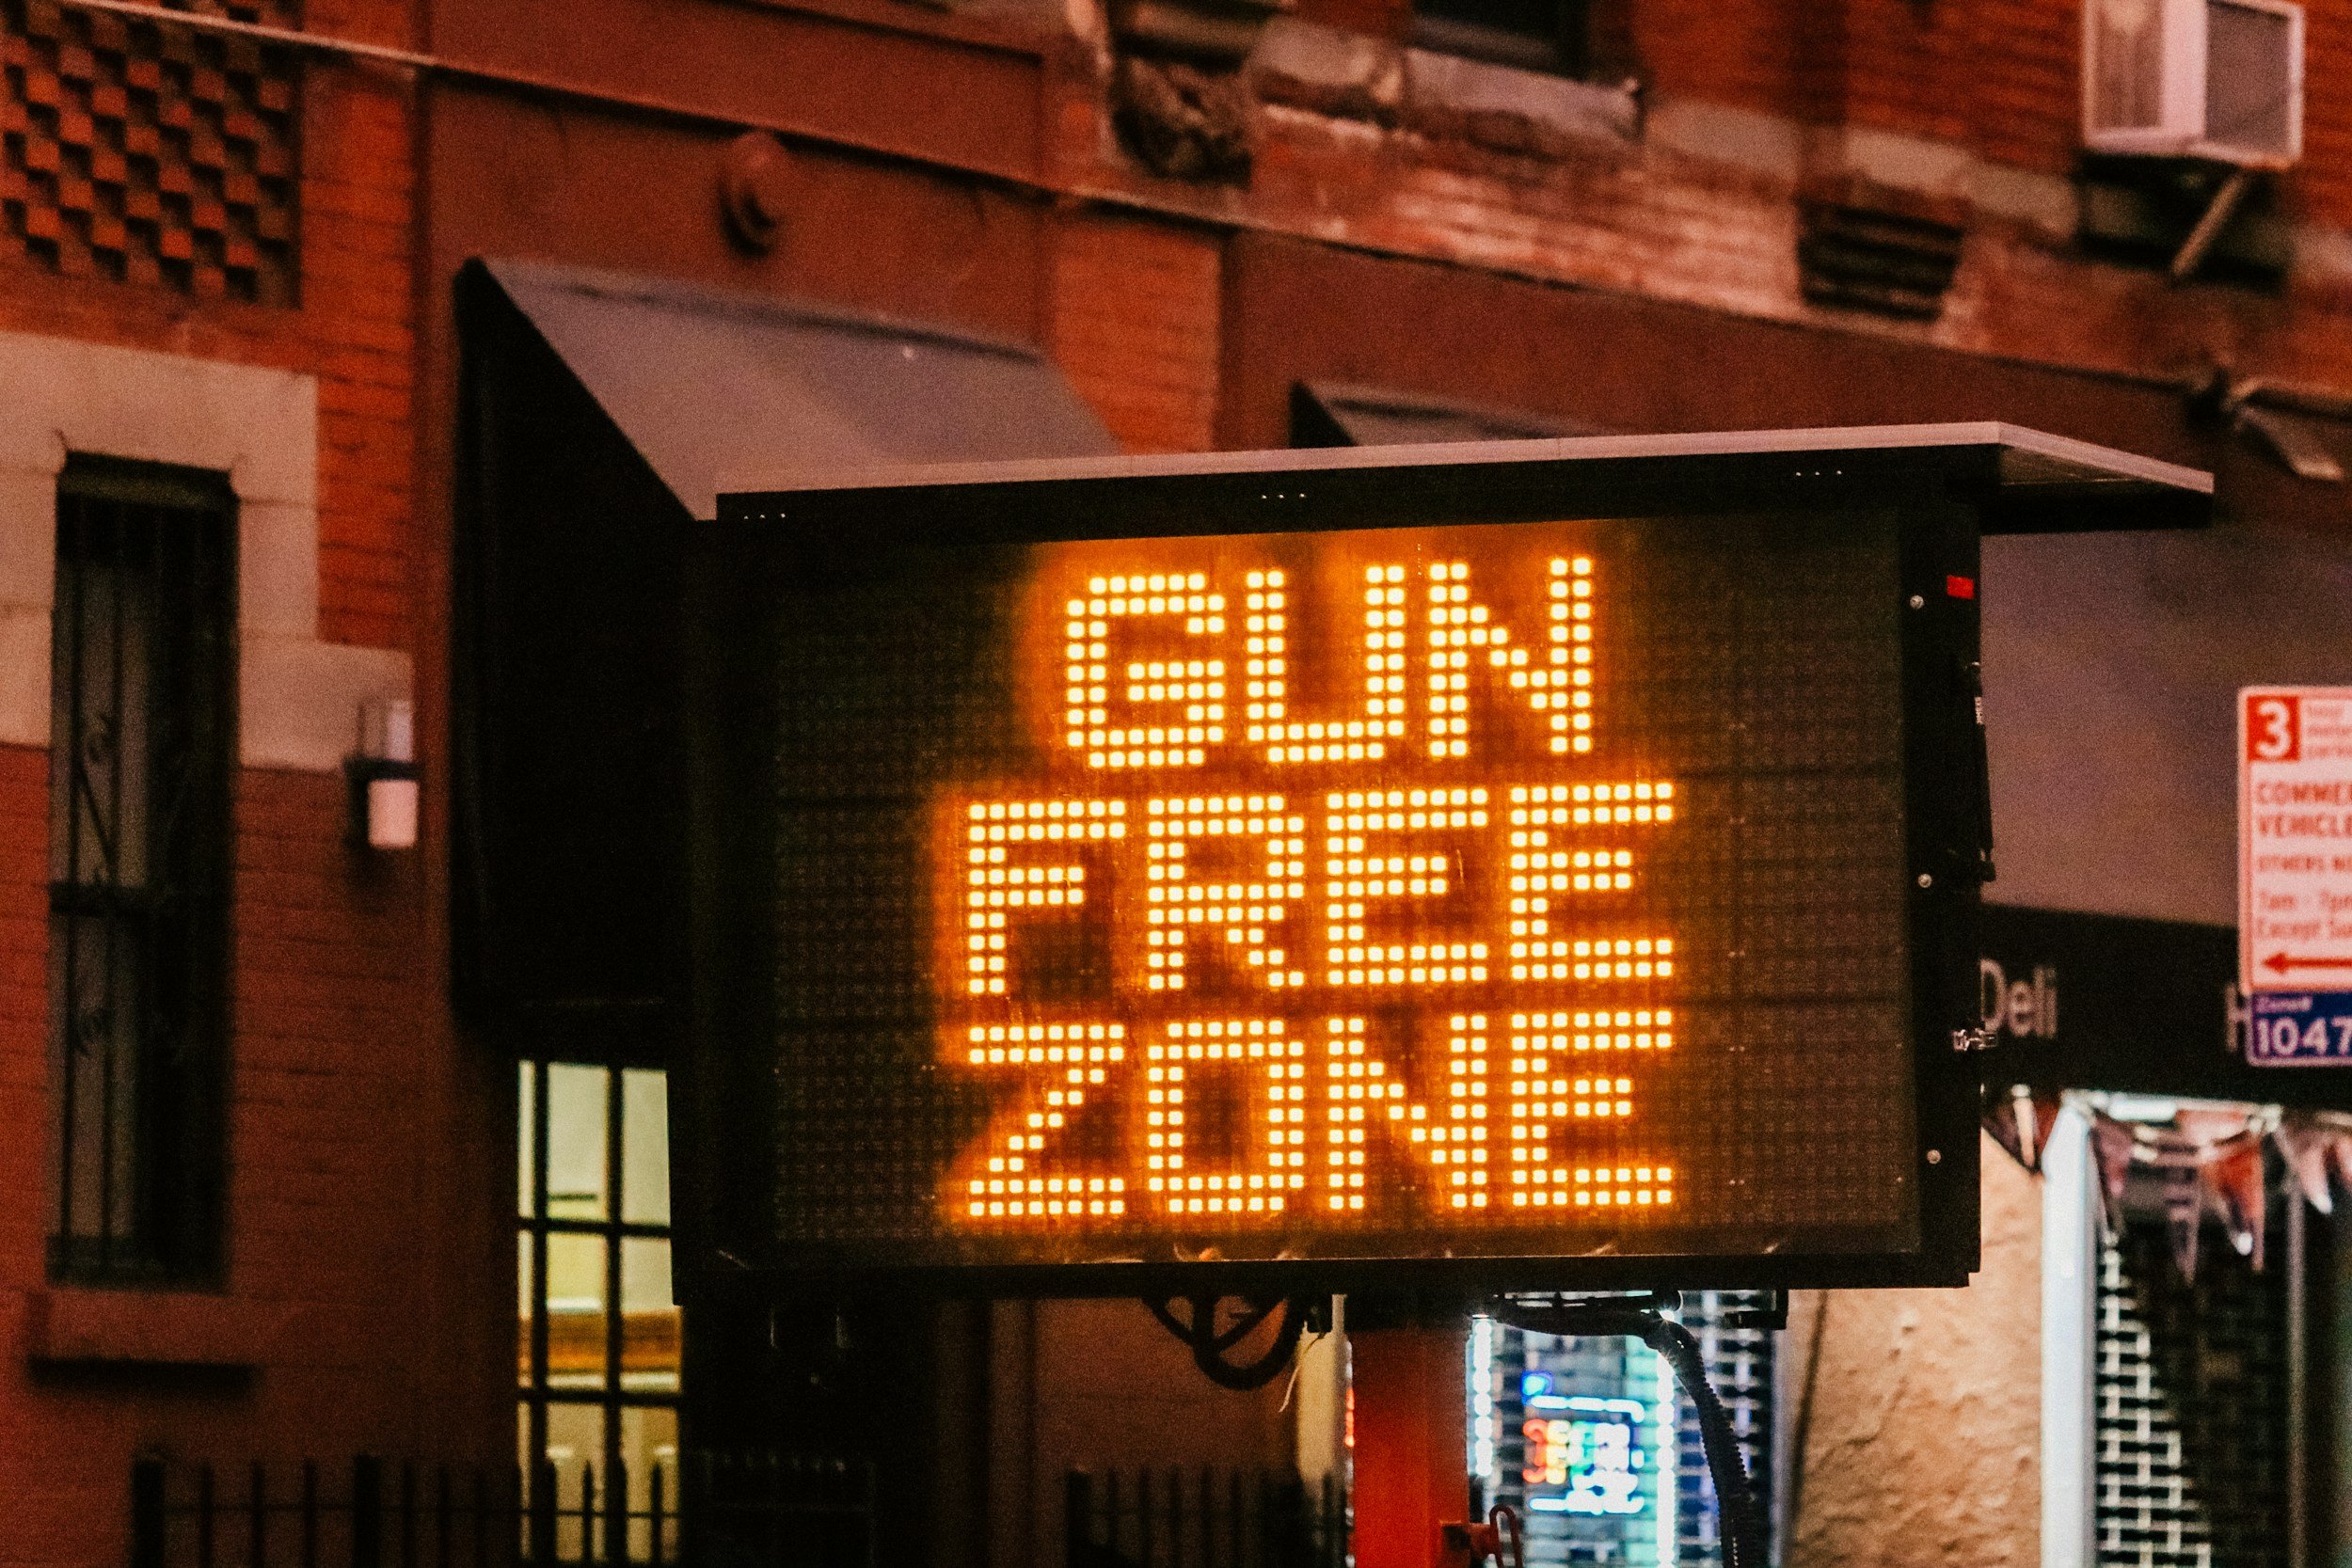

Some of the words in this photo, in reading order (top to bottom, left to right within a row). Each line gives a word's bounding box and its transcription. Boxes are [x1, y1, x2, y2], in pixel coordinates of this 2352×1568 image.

[1067, 558, 1591, 768] GUN
[2257, 700, 2290, 758] 3
[969, 783, 1673, 993] FREE
[1979, 958, 2058, 1038] Deli
[969, 1010, 1673, 1216] ZONE
